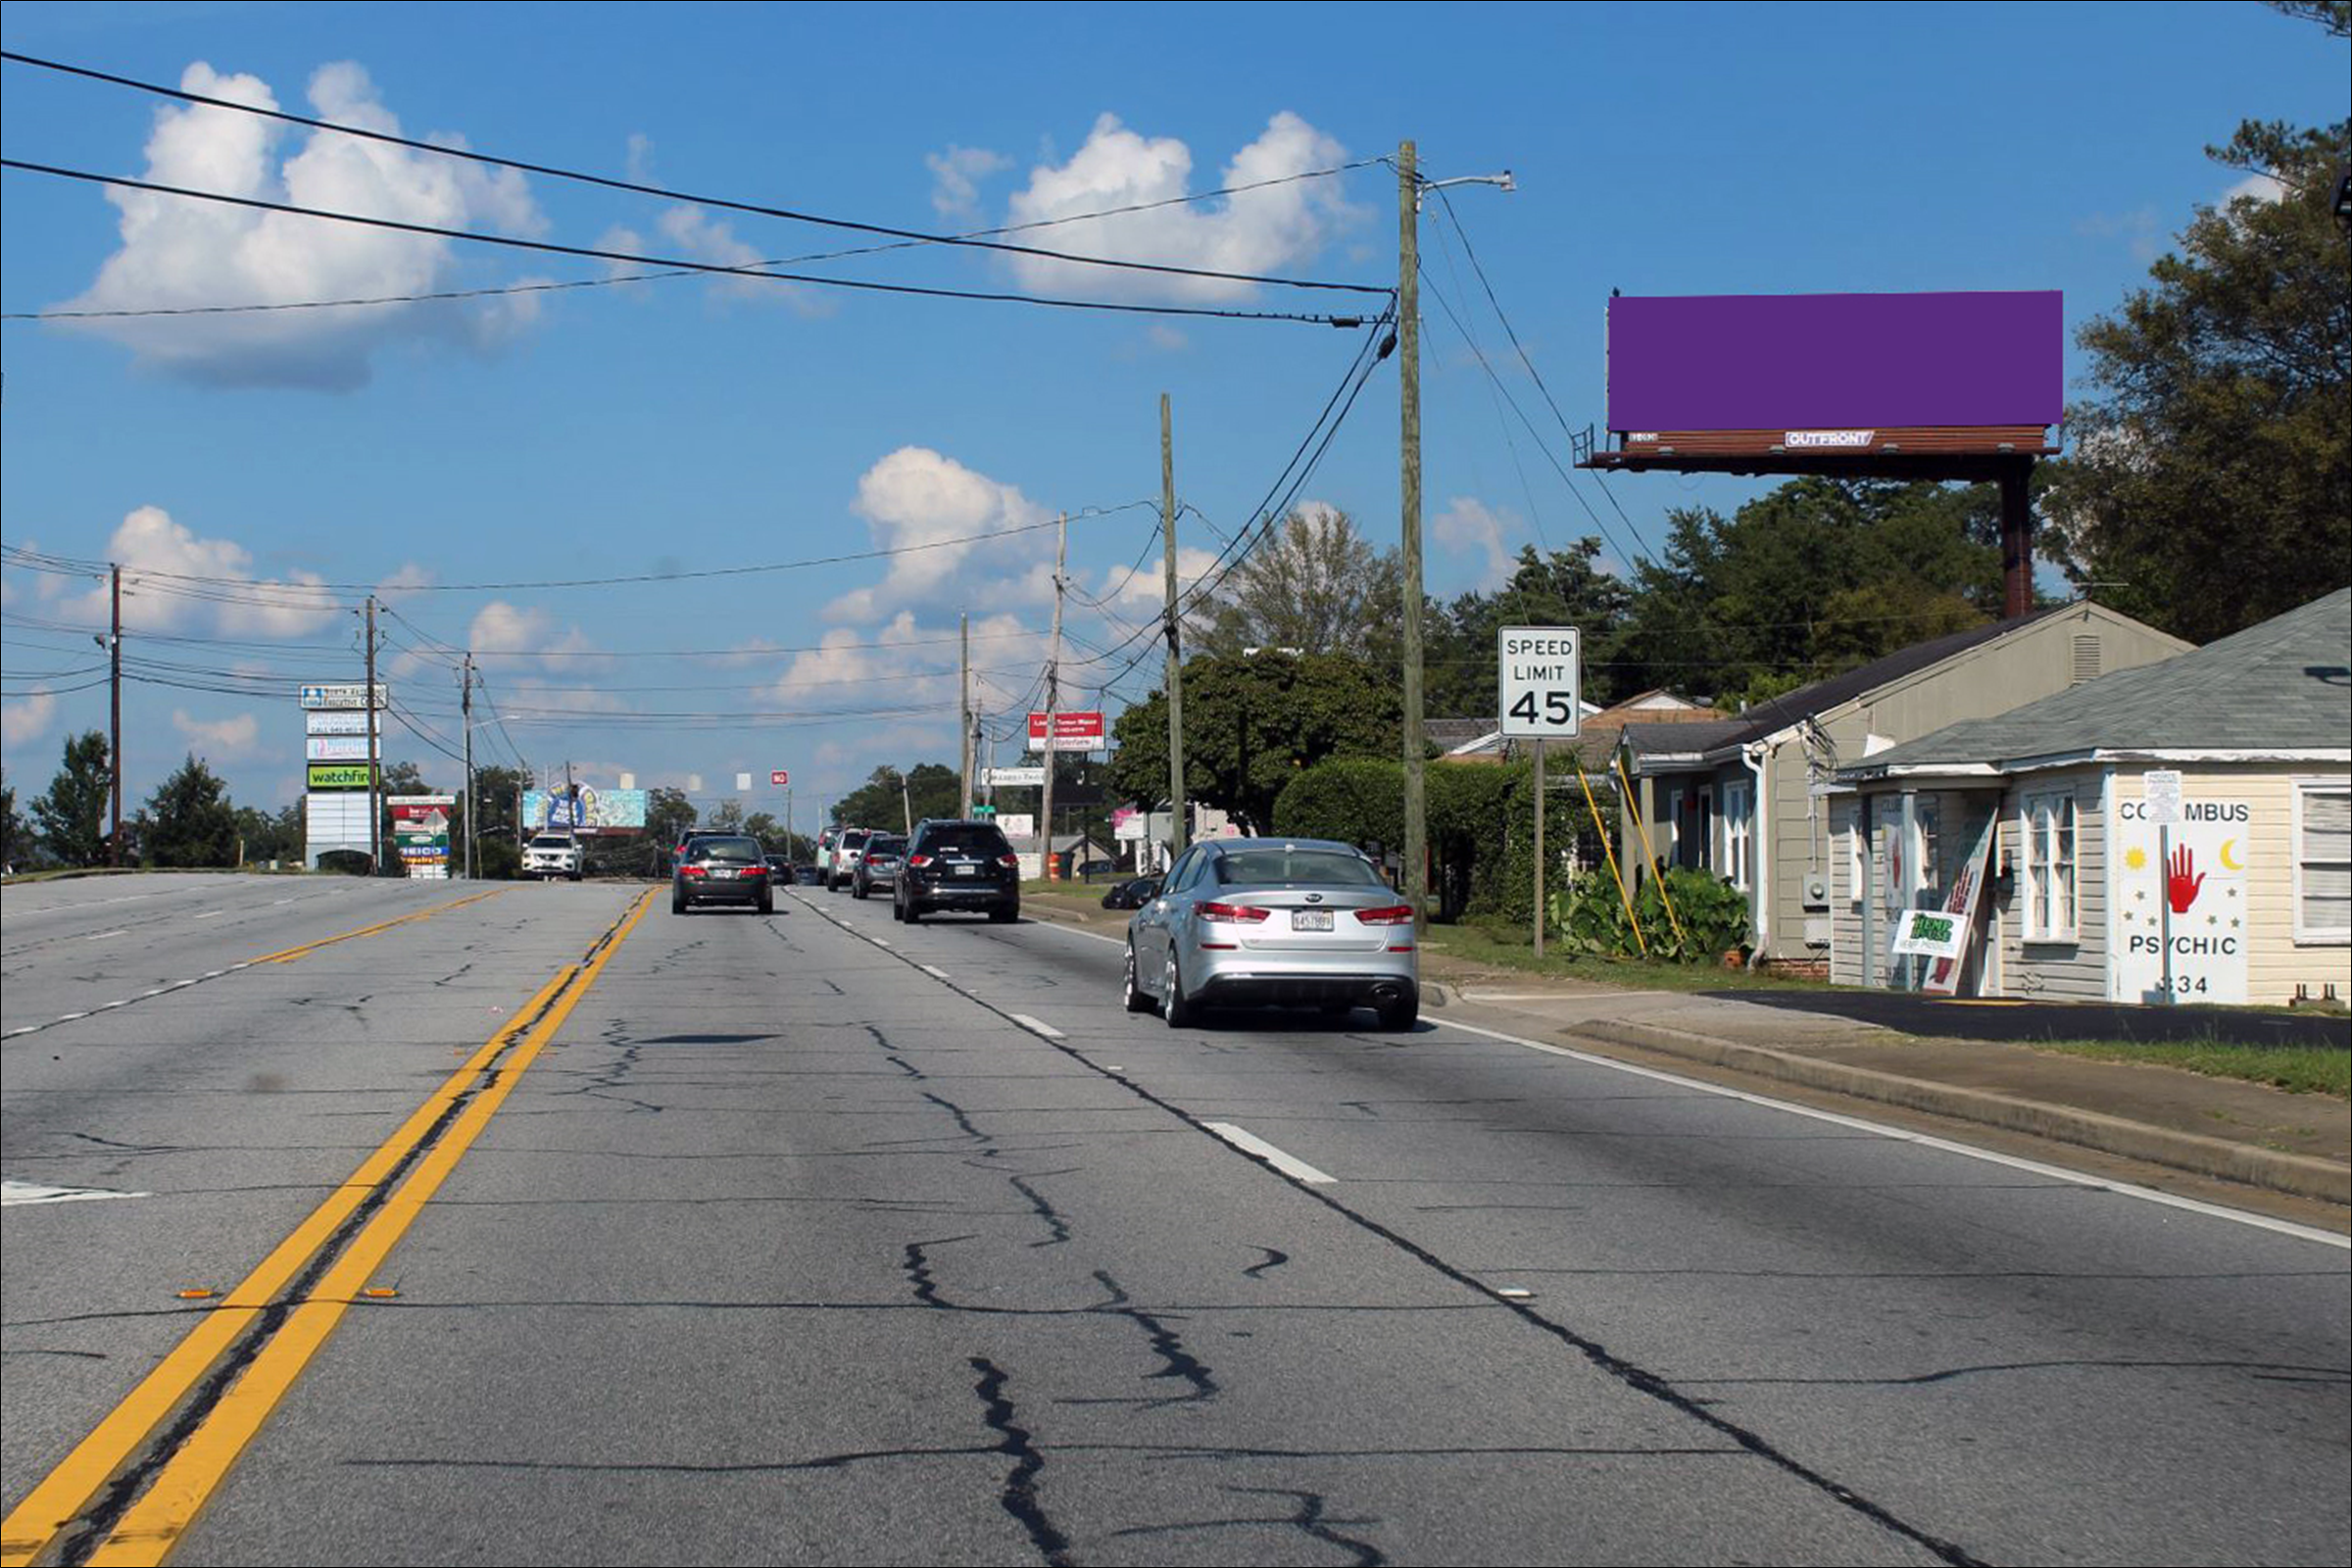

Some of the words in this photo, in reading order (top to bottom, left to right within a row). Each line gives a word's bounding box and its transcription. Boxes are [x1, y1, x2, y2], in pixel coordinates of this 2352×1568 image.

[1788, 432, 1870, 446] OUTFRONT
[1507, 639, 1573, 656] SPEED
[1514, 665, 1565, 681] LIMIT
[1509, 690, 1571, 725] 45
[312, 769, 369, 783] watchfir
[2121, 802, 2249, 822] COMBUS
[1912, 915, 1953, 931] HEMP
